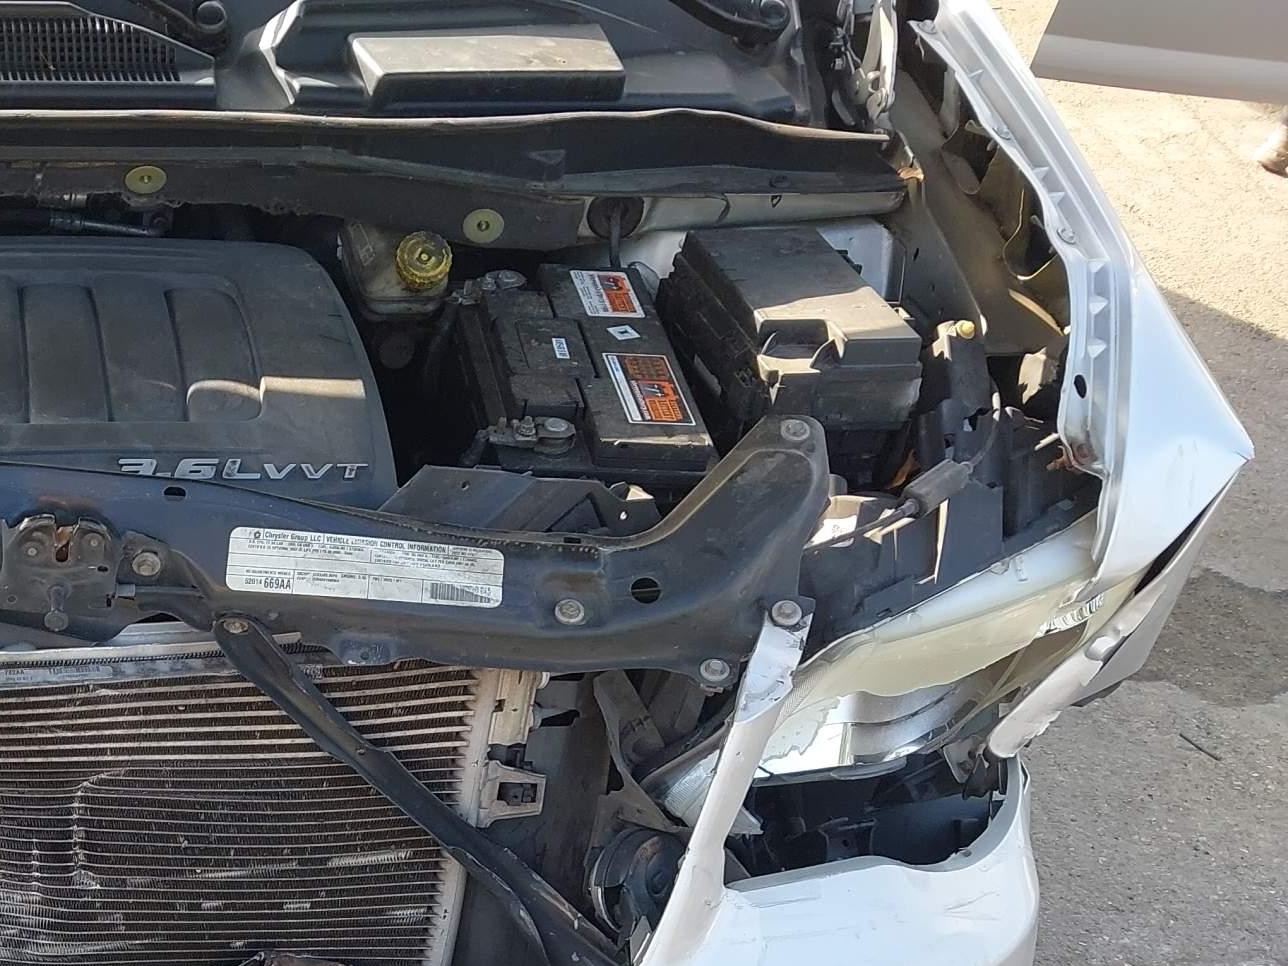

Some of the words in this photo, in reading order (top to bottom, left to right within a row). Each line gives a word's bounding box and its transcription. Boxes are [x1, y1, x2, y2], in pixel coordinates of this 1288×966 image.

[263, 463, 368, 479] VVT
[264, 531, 290, 541] Chrysler
[290, 534, 309, 543] Group
[310, 535, 322, 543] LLC
[326, 536, 350, 545] VEHICLE
[380, 541, 405, 549] CONTROL
[407, 543, 446, 553] INFORMATION
[263, 577, 291, 589] 669AA
